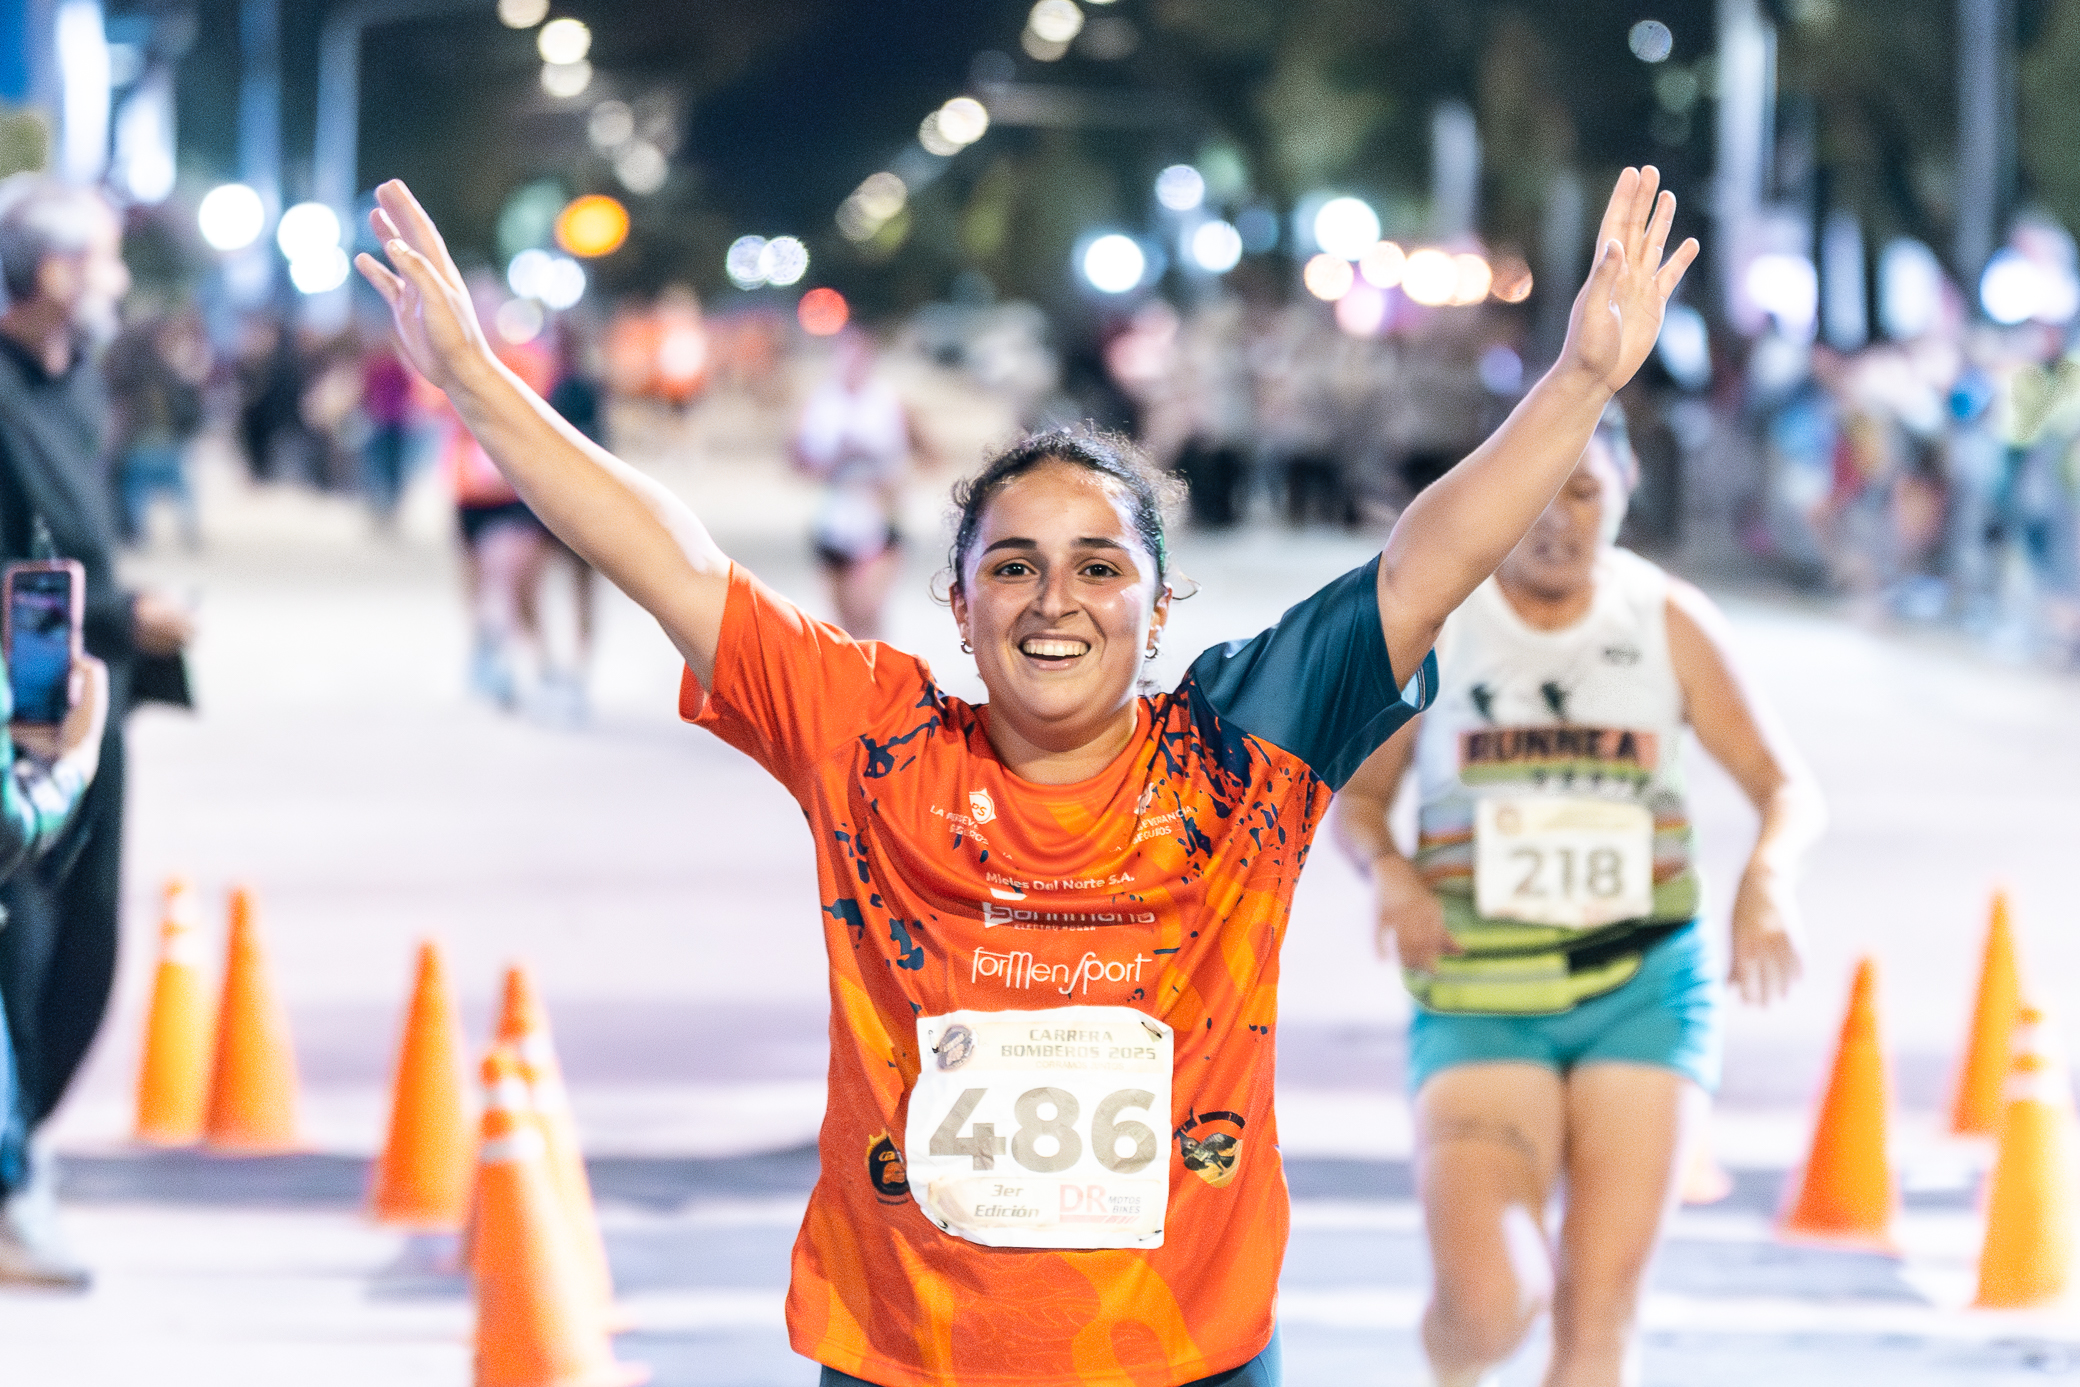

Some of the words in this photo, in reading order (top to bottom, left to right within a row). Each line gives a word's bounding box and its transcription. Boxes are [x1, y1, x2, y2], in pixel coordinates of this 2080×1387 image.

[985, 871, 1030, 889] Mieles
[1063, 878, 1105, 890] Norte
[1108, 871, 1136, 885] S.A.
[1509, 846, 1625, 901] 218
[1029, 1029, 1113, 1043] CARRERA
[1001, 1044, 1099, 1059] BOMBEROS
[1108, 1046, 1156, 1060] 2025
[928, 1086, 1158, 1174] 486
[991, 1184, 1024, 1197] 3er
[1059, 1184, 1108, 1213] DR
[1108, 1196, 1141, 1205] MOTOS
[974, 1204, 1040, 1218] Edición
[1112, 1205, 1141, 1214] BIKES
